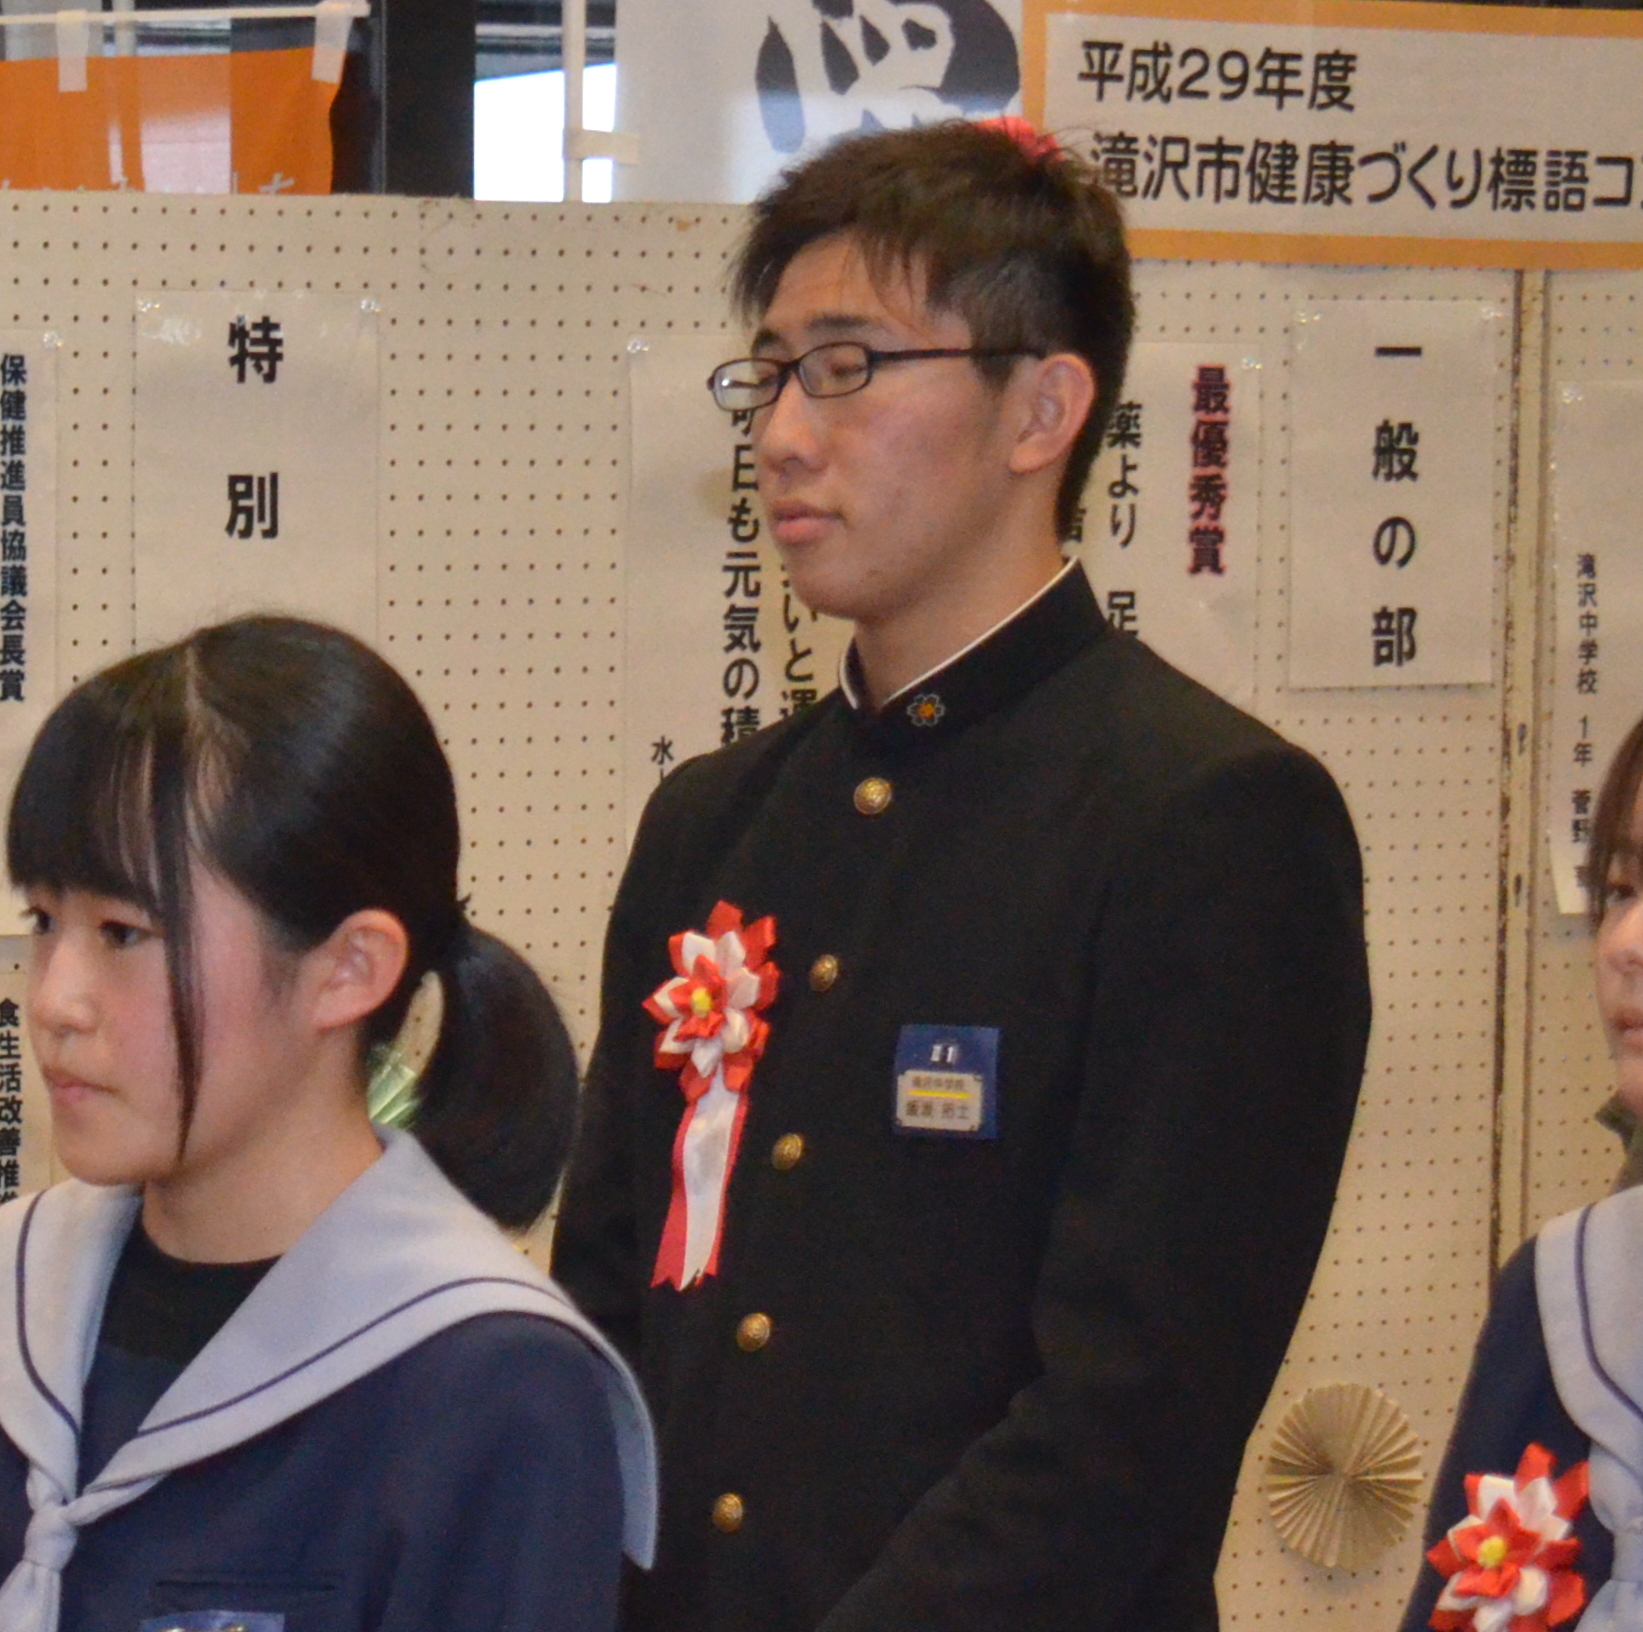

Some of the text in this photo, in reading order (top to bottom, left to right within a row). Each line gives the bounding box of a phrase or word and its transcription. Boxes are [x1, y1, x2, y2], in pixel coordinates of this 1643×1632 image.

[1078, 38, 1358, 112] 平成29年度
[1090, 131, 1643, 213] 滝沢市健康づくり標語コ
[1187, 366, 1232, 577] 最優秀賞
[1371, 345, 1423, 668] 一般の部
[1576, 553, 1599, 695] 滝沢中学校
[651, 735, 675, 780] 水
[1572, 715, 1593, 768] 1年
